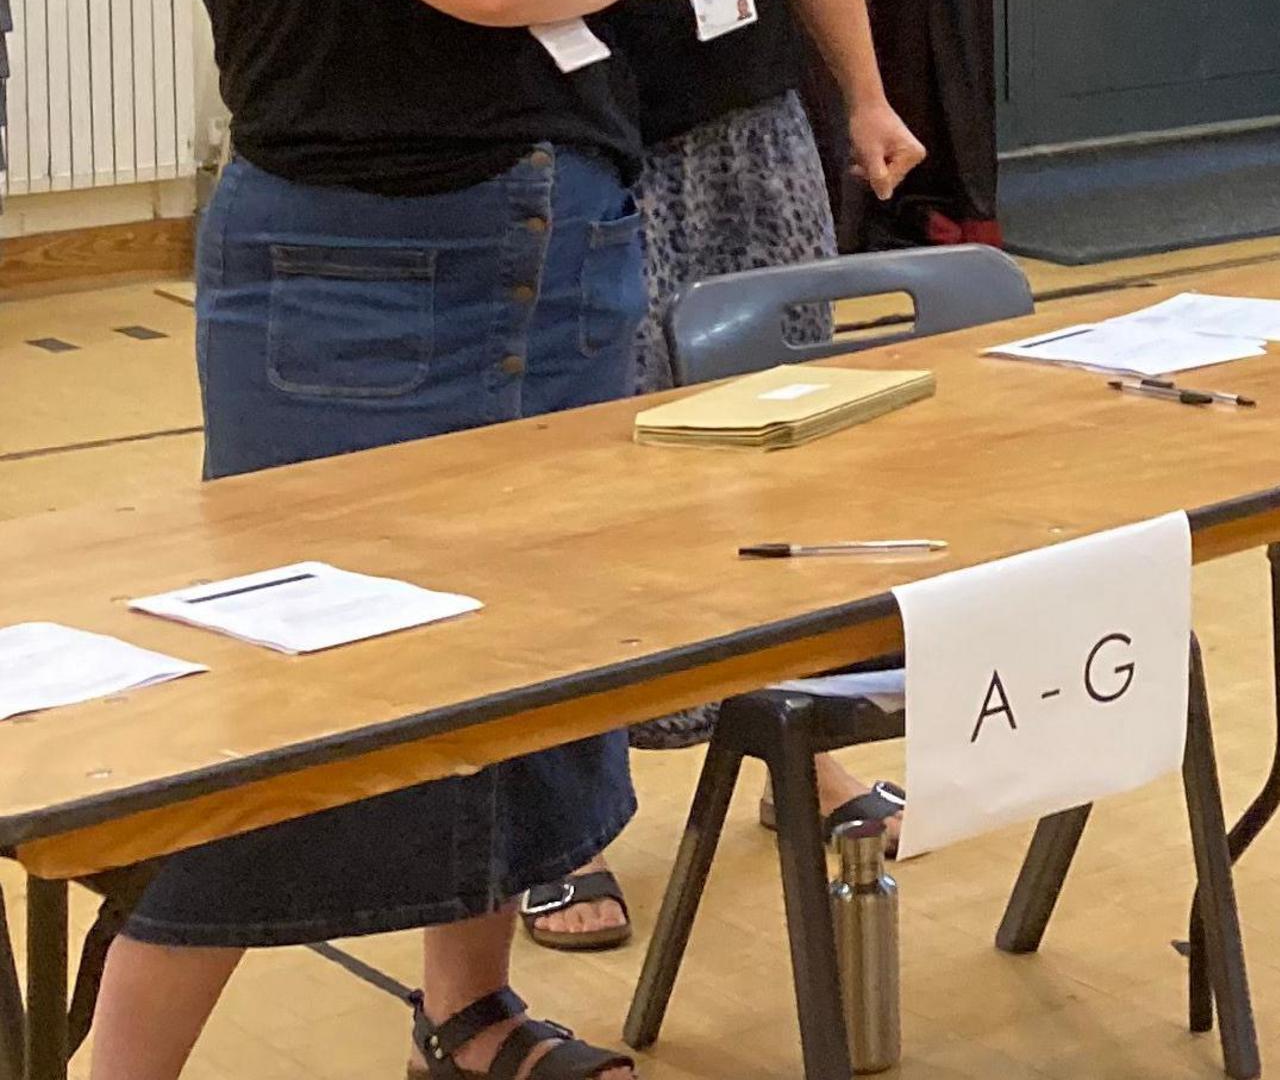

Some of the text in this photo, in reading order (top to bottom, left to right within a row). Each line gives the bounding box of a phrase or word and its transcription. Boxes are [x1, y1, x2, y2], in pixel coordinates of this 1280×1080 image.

[970, 632, 1135, 743] A - G
